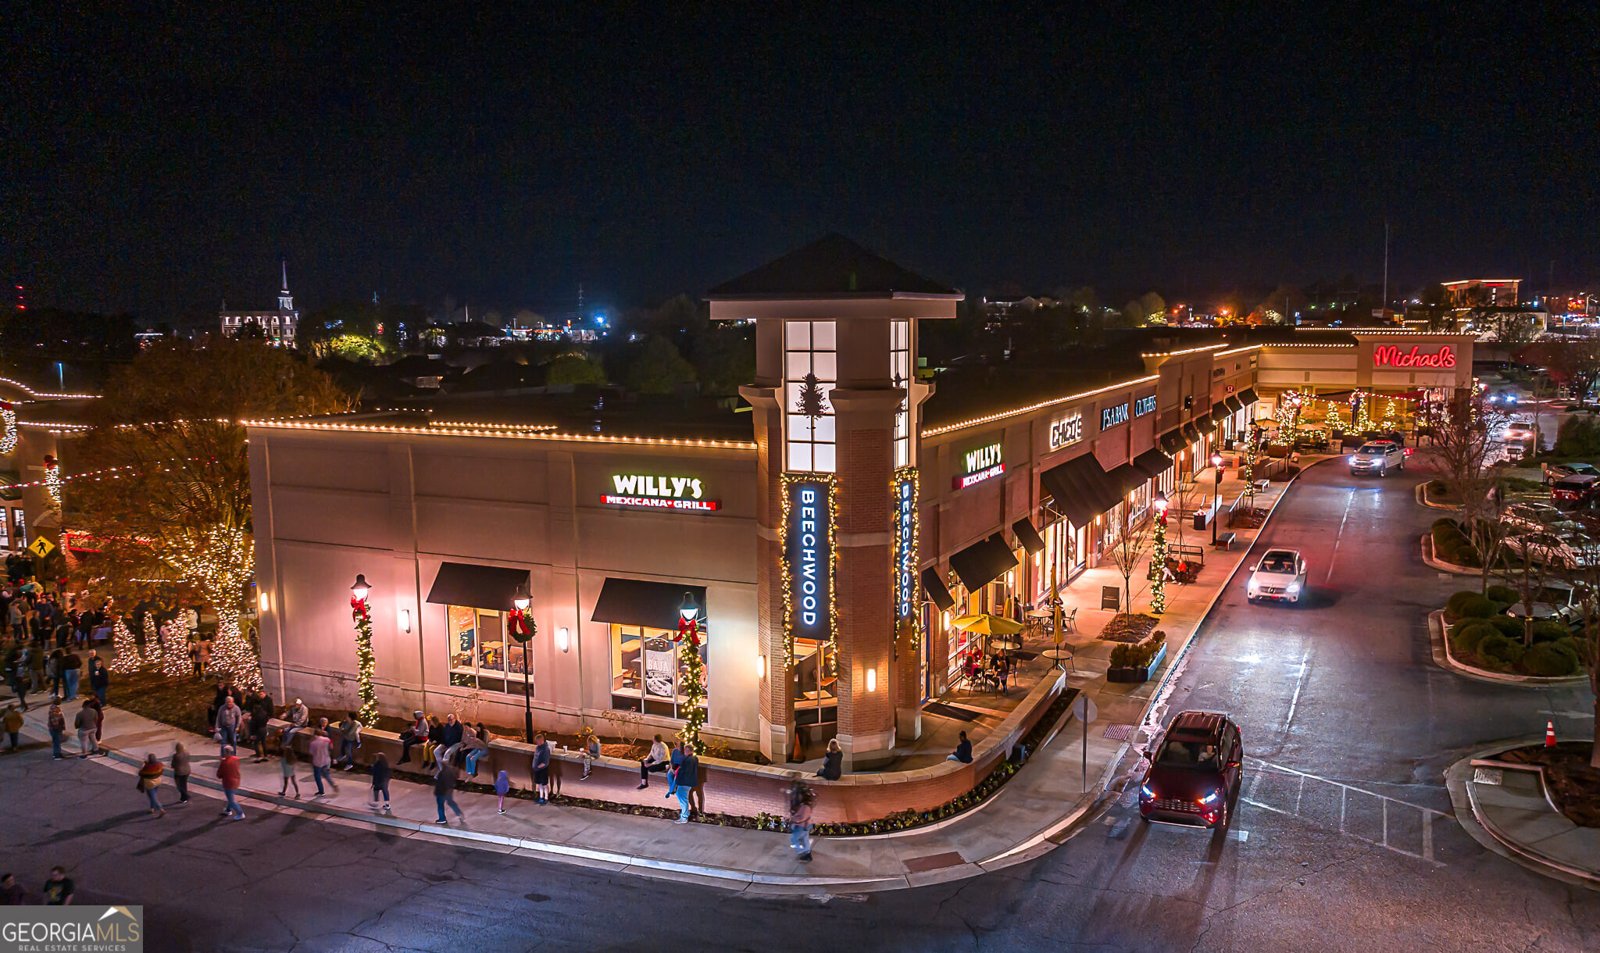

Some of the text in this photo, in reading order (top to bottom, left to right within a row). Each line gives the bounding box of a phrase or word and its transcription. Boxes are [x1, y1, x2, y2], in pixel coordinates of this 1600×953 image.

[1374, 345, 1456, 368] Michaels
[966, 443, 1001, 473] WILLY'S
[612, 475, 703, 499] WILLY'S
[801, 490, 816, 625] BEECHWOOD
[902, 484, 910, 616] BEECHWOOD
